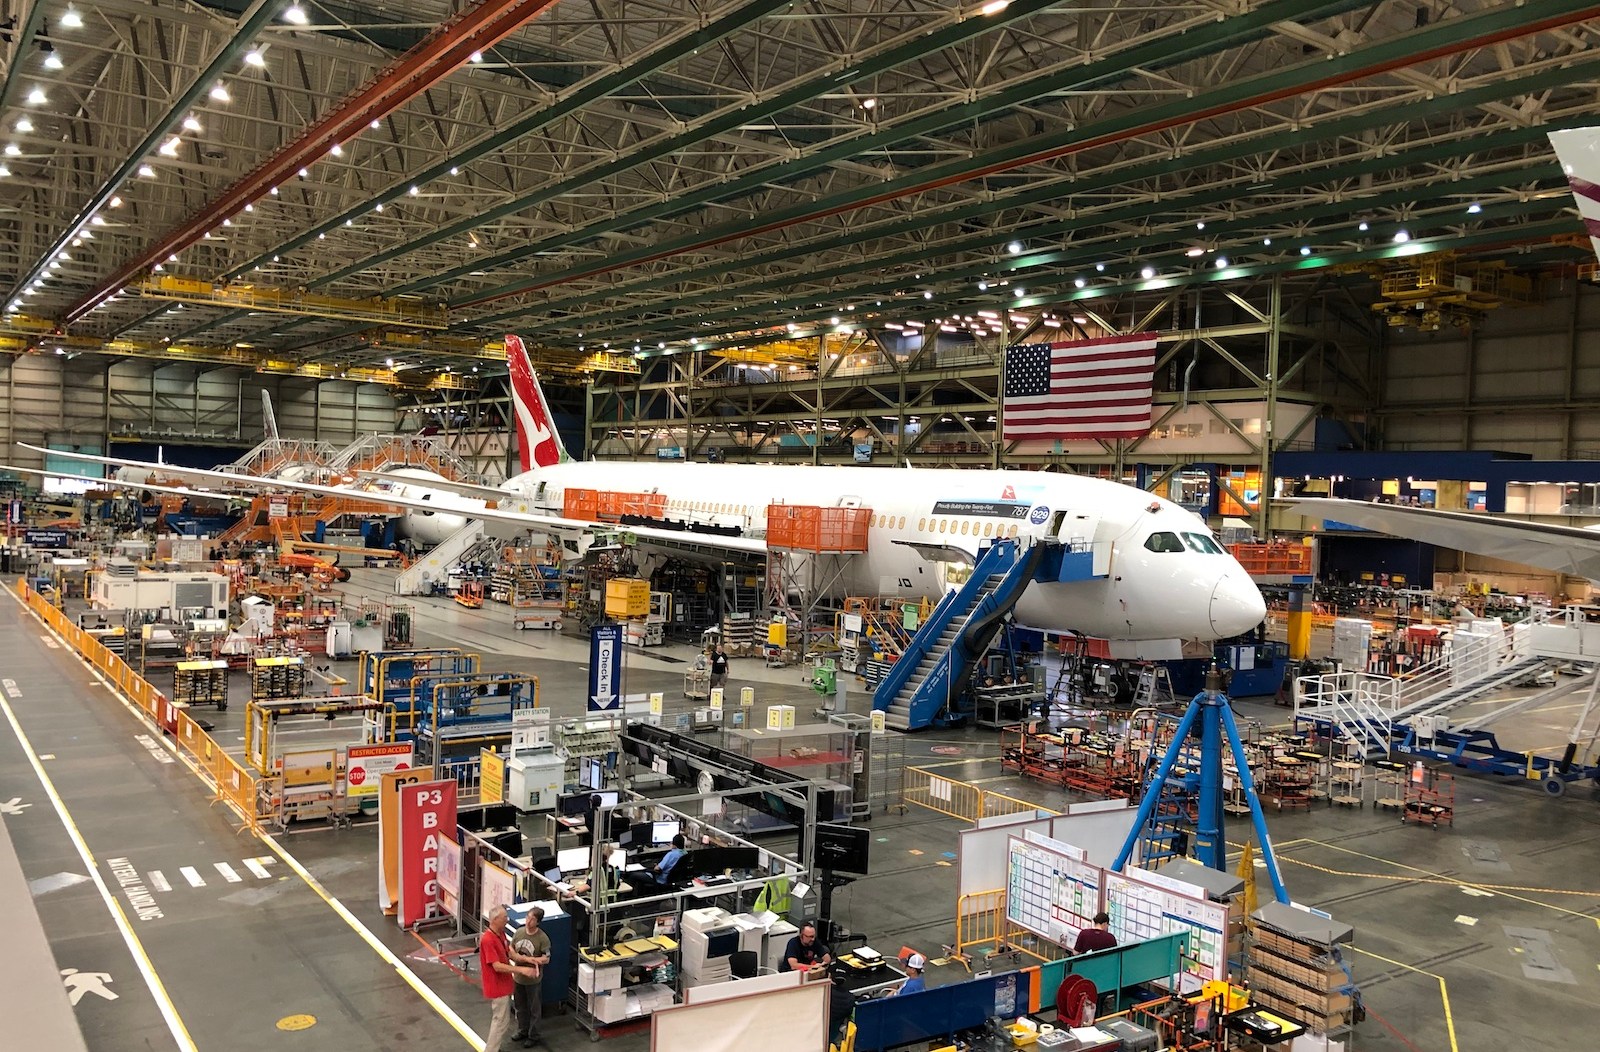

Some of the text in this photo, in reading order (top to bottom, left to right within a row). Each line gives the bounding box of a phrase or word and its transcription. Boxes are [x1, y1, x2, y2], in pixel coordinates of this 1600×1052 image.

[1011, 506, 1030, 517] 787
[1031, 510, 1049, 520] 929
[601, 649, 610, 681] Check
[600, 683, 608, 693] In
[351, 746, 410, 757] RESTRICTED ACCESS
[350, 772, 365, 780] STOP
[416, 790, 442, 807] P3
[422, 811, 438, 919] BARGE
[106, 857, 164, 921] MATERIAL HANDLING
